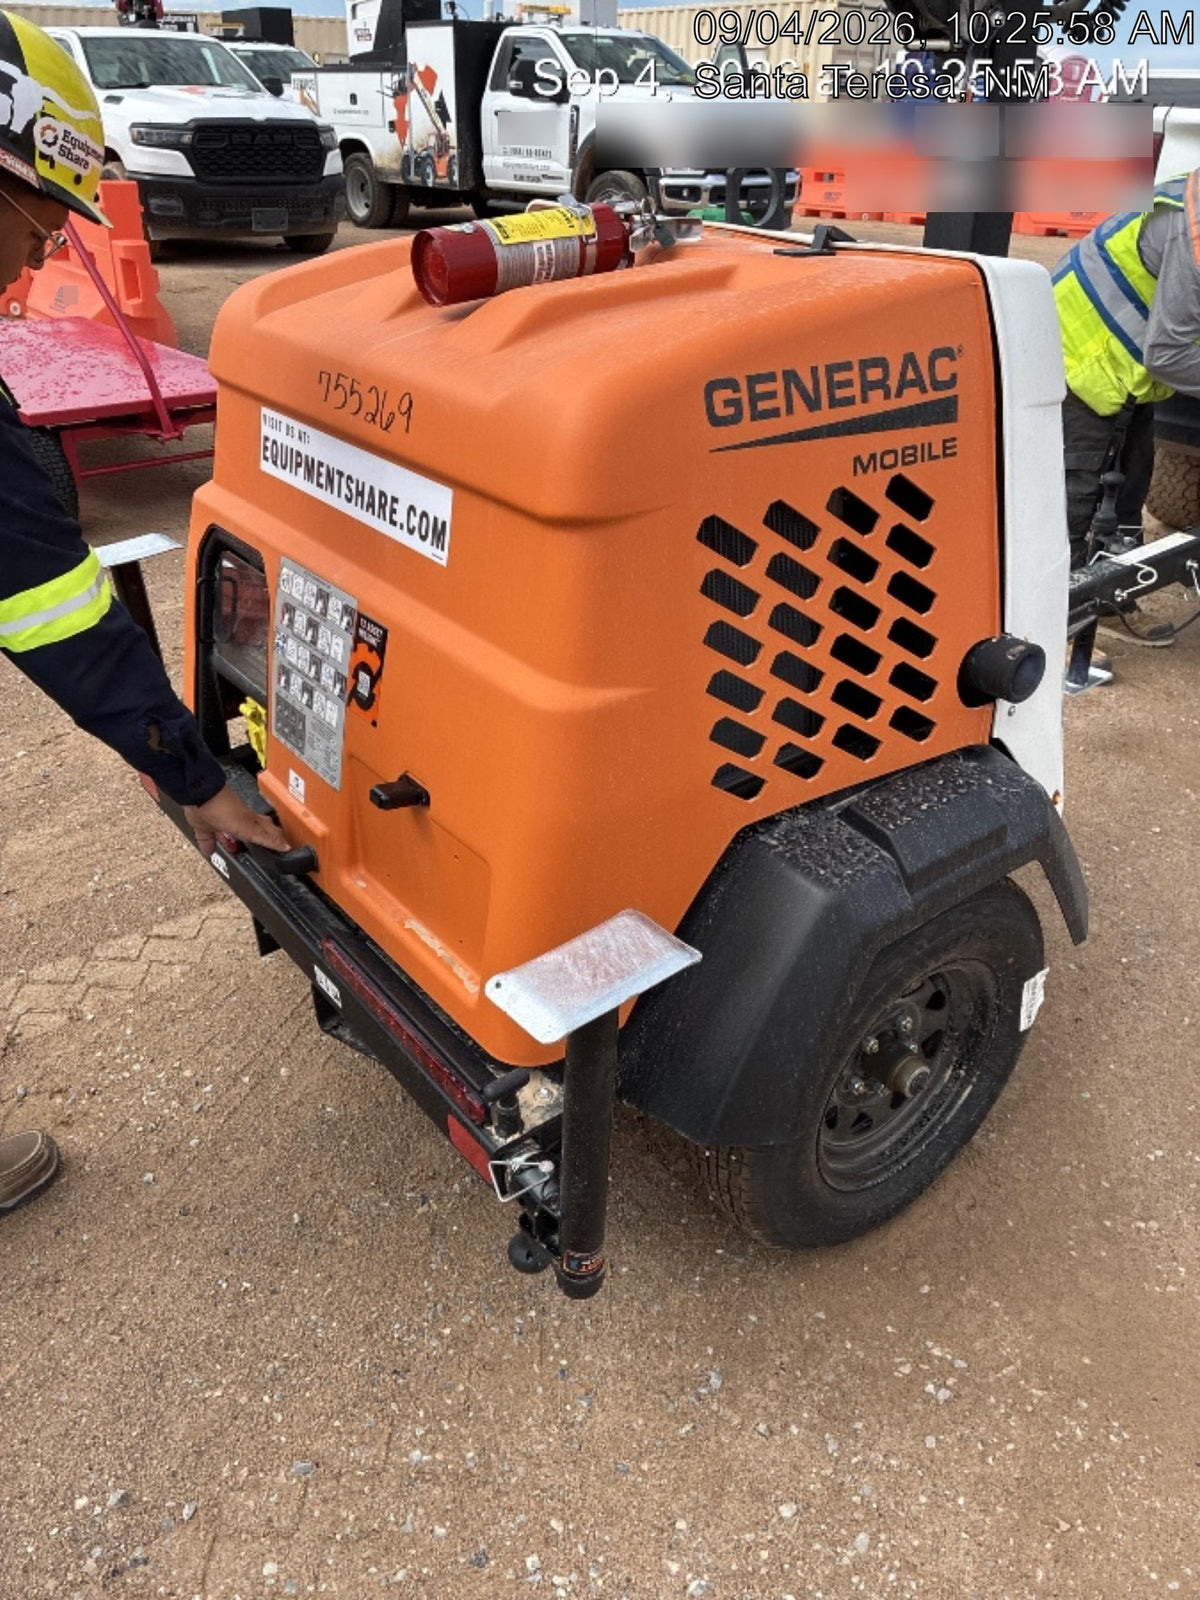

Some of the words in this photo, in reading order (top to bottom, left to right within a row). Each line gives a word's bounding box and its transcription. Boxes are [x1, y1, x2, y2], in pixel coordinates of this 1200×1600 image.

[58, 144, 90, 170] Share
[317, 370, 414, 434] 755269
[703, 345, 959, 428] GENERAC
[263, 413, 281, 433] VISIT
[286, 423, 295, 439] US
[298, 429, 310, 445] AT:
[853, 437, 958, 477] MOBILE
[262, 435, 448, 552] EQUIPMENTSHARE.COM
